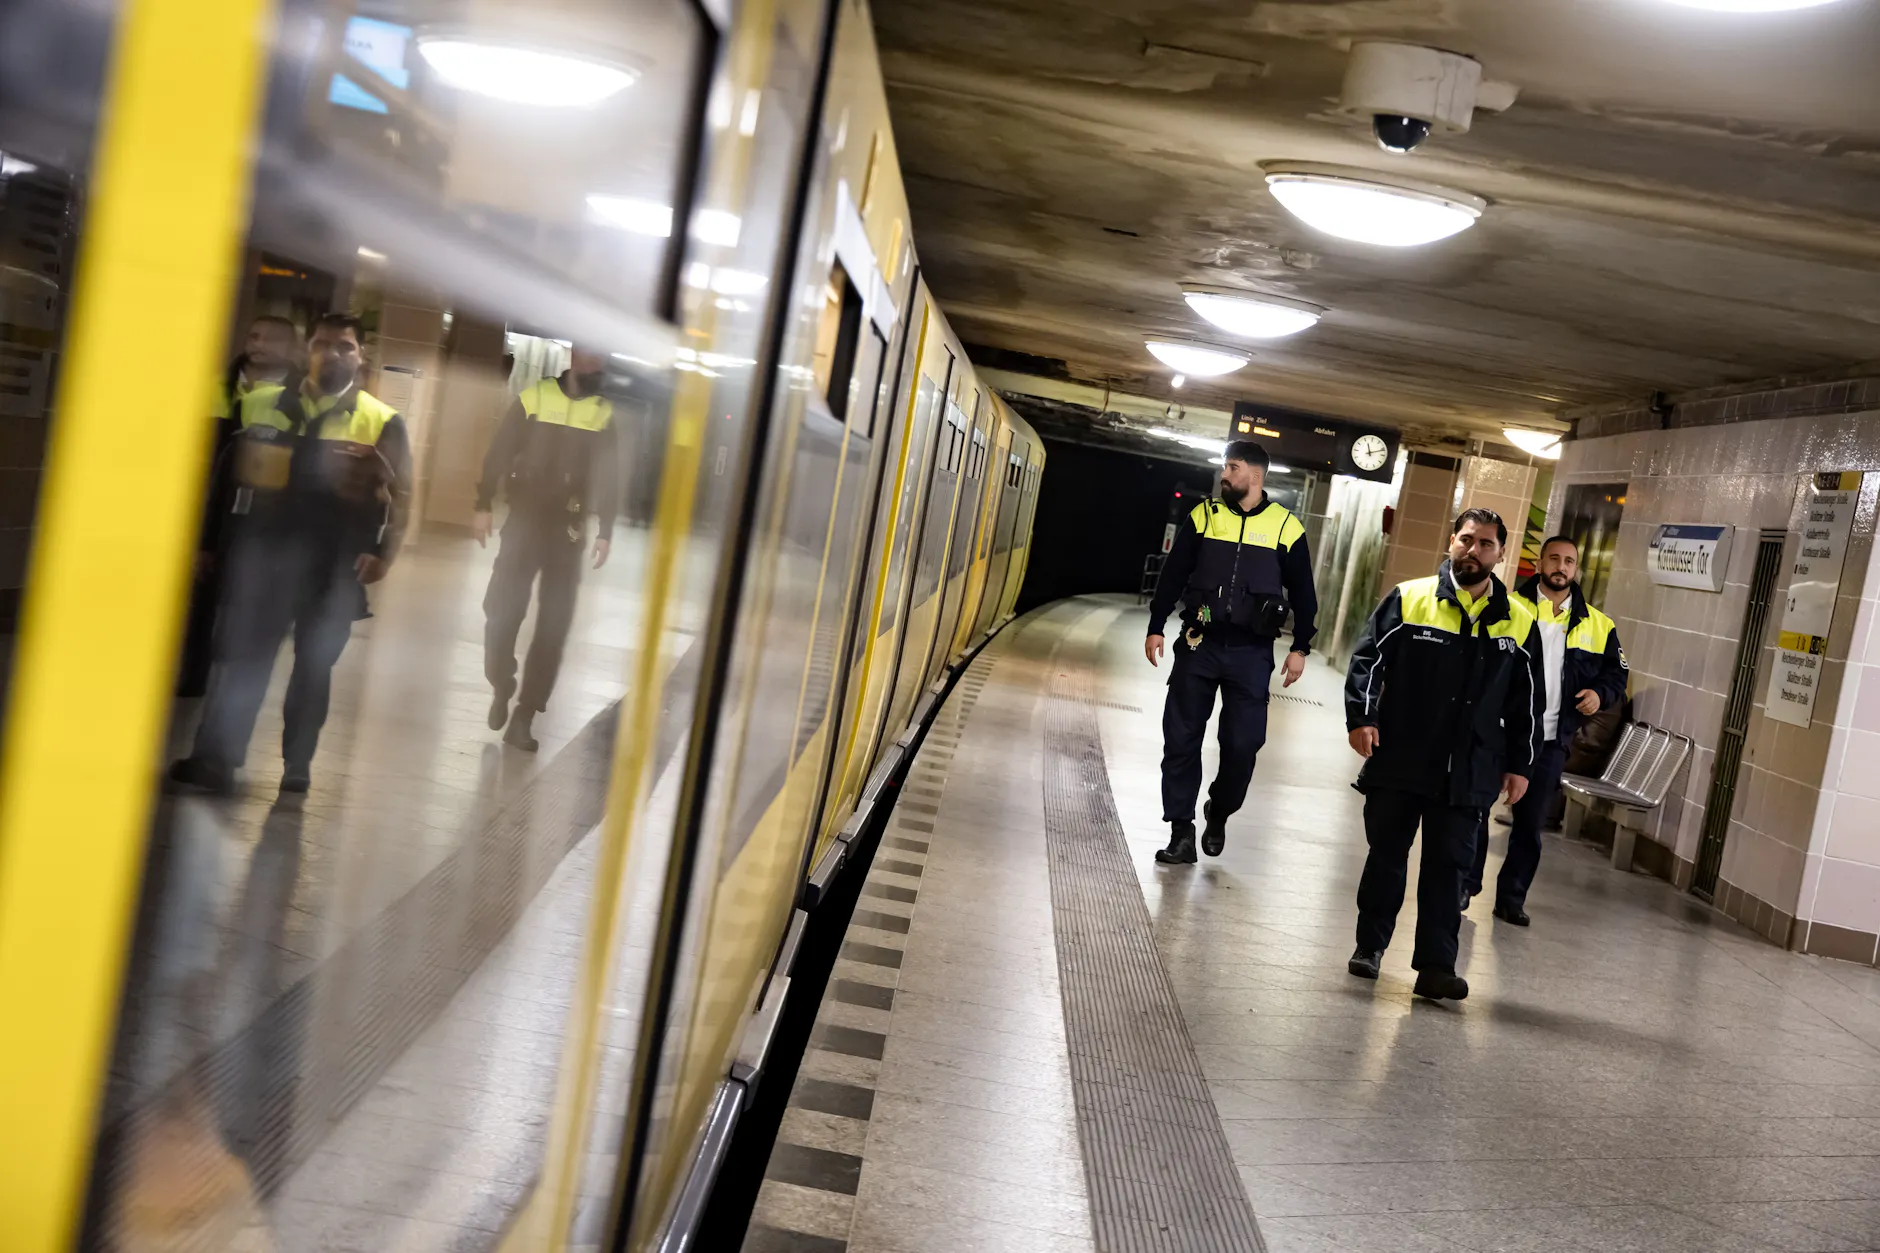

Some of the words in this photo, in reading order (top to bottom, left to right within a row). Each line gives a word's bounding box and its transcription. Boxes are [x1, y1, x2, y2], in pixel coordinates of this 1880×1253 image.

[1241, 414, 1254, 422] Linie
[1256, 416, 1267, 424] Ziel
[1314, 427, 1336, 437] Abfahrt
[1249, 532, 1267, 544] BVG
[1658, 541, 1696, 574] Kottbusser
[1697, 545, 1710, 575] Tor
[1498, 638, 1516, 654] BVG
